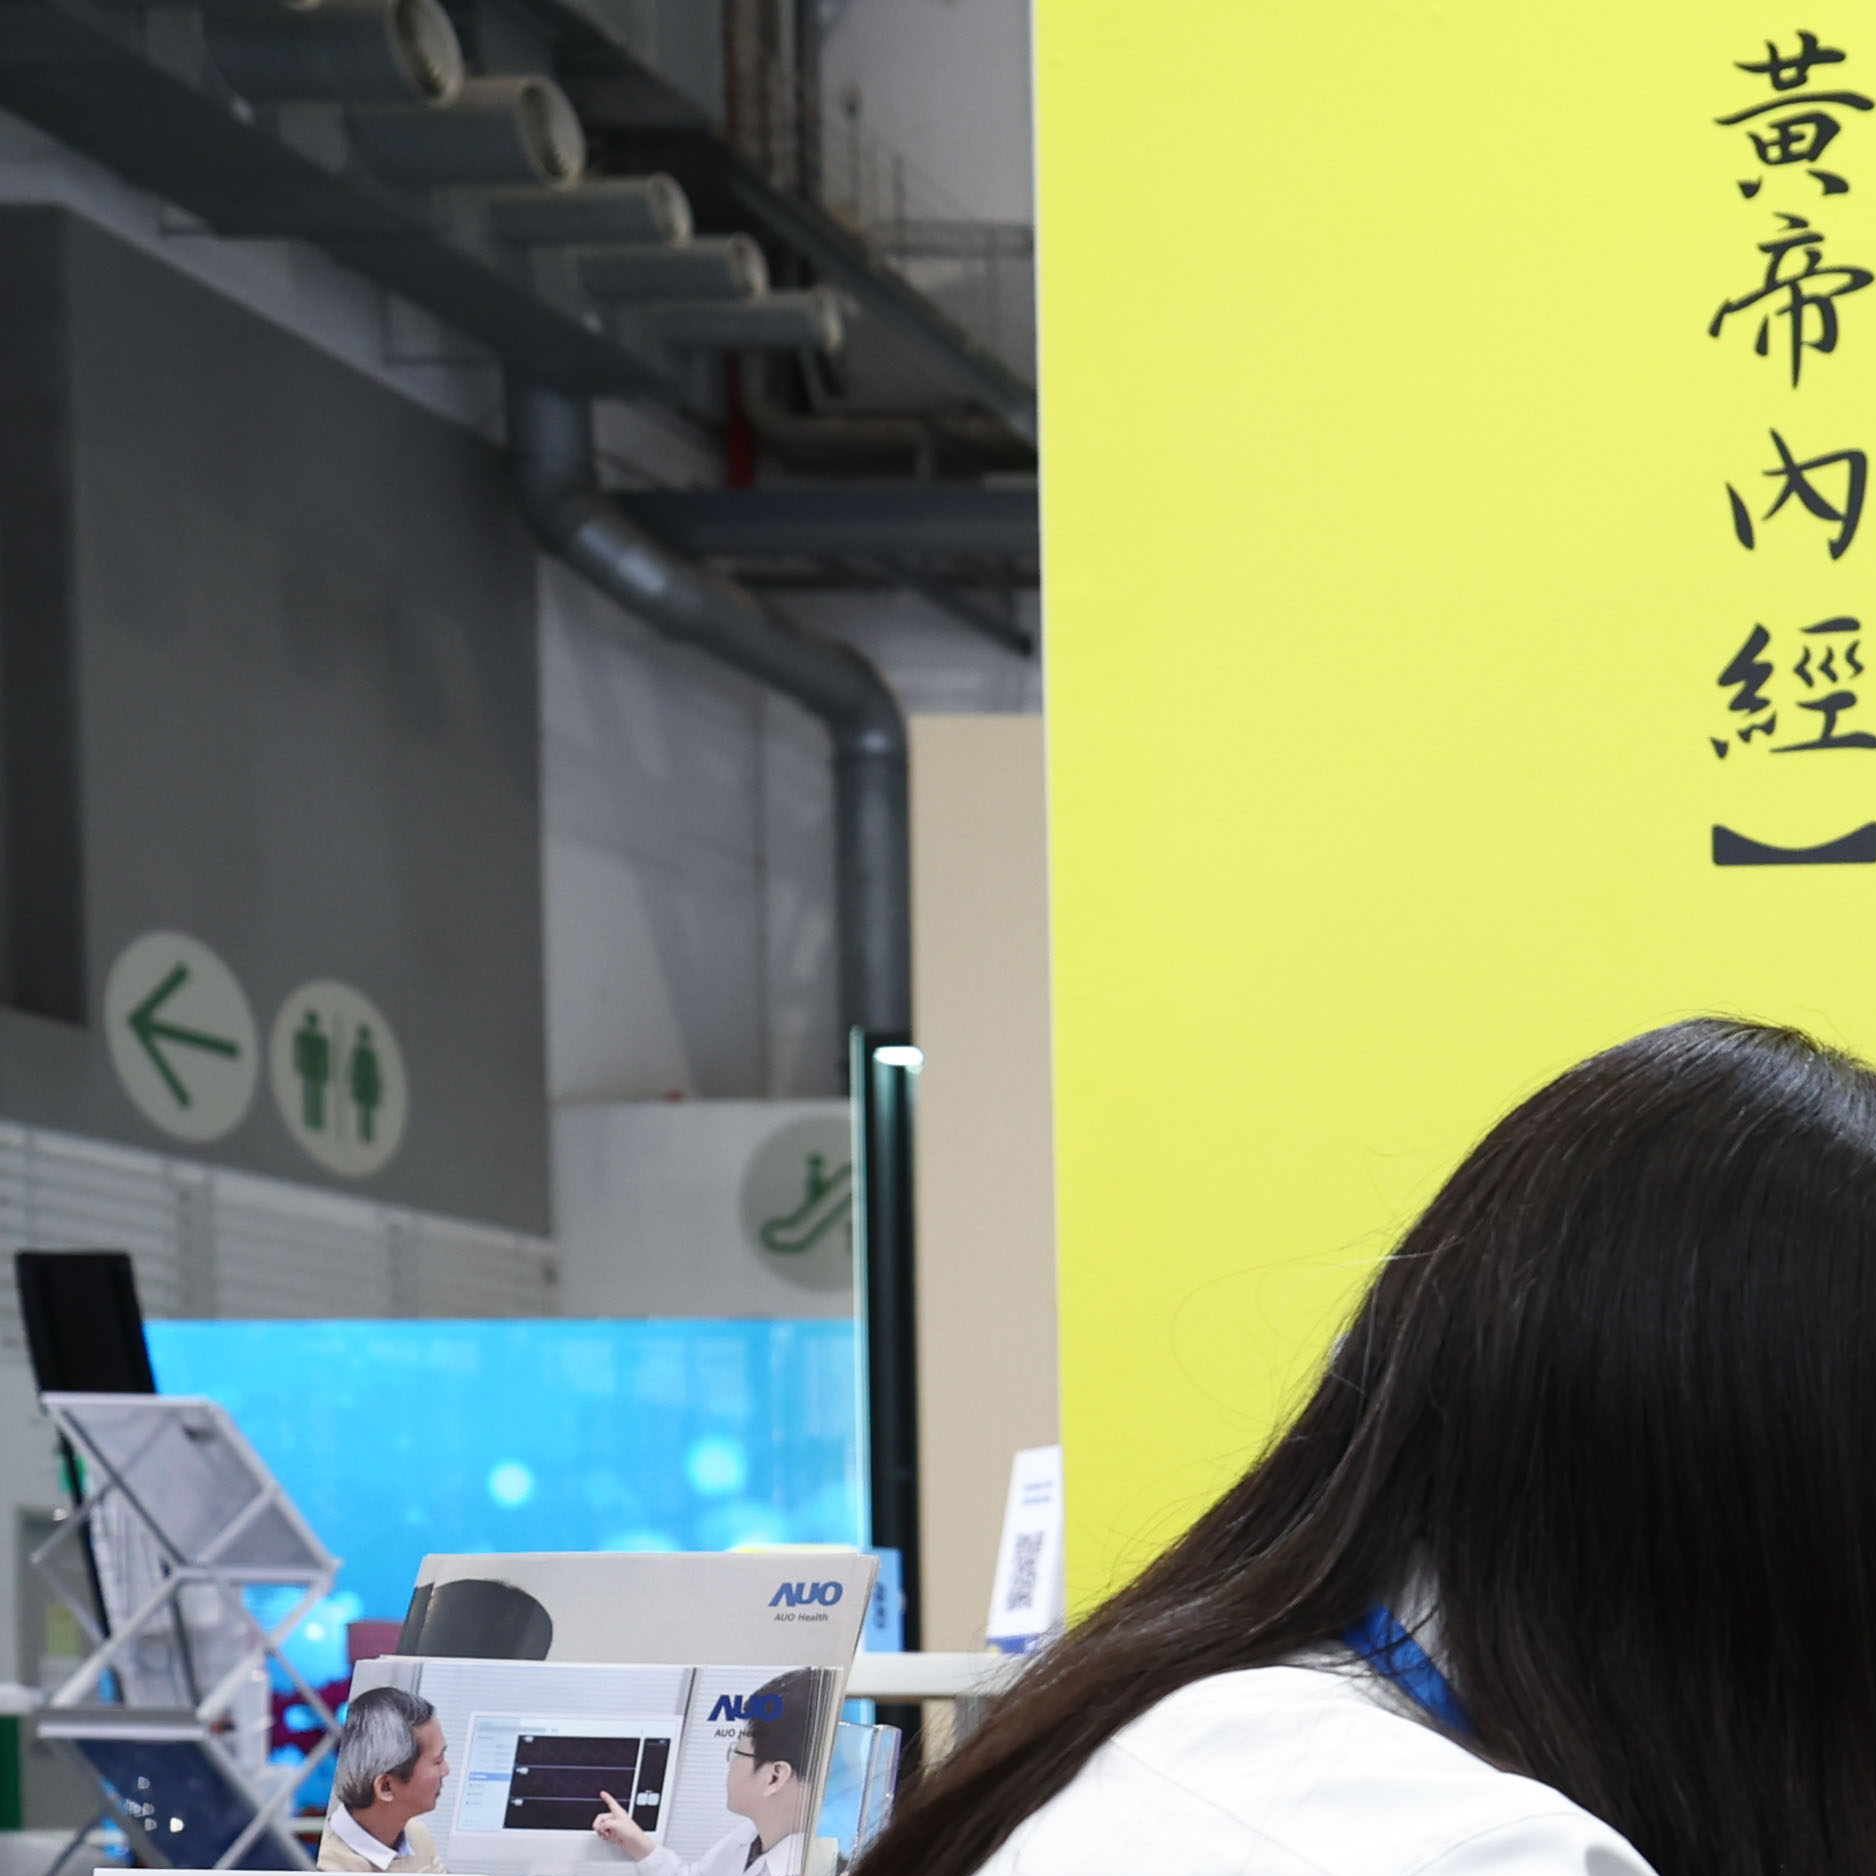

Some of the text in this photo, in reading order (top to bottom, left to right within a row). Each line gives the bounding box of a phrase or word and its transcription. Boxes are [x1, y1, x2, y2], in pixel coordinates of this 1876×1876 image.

[767, 1581, 844, 1607] AUO
[774, 1612, 829, 1622] AUO Health
[706, 1693, 785, 1722] AUO
[714, 1728, 736, 1738] AUO
